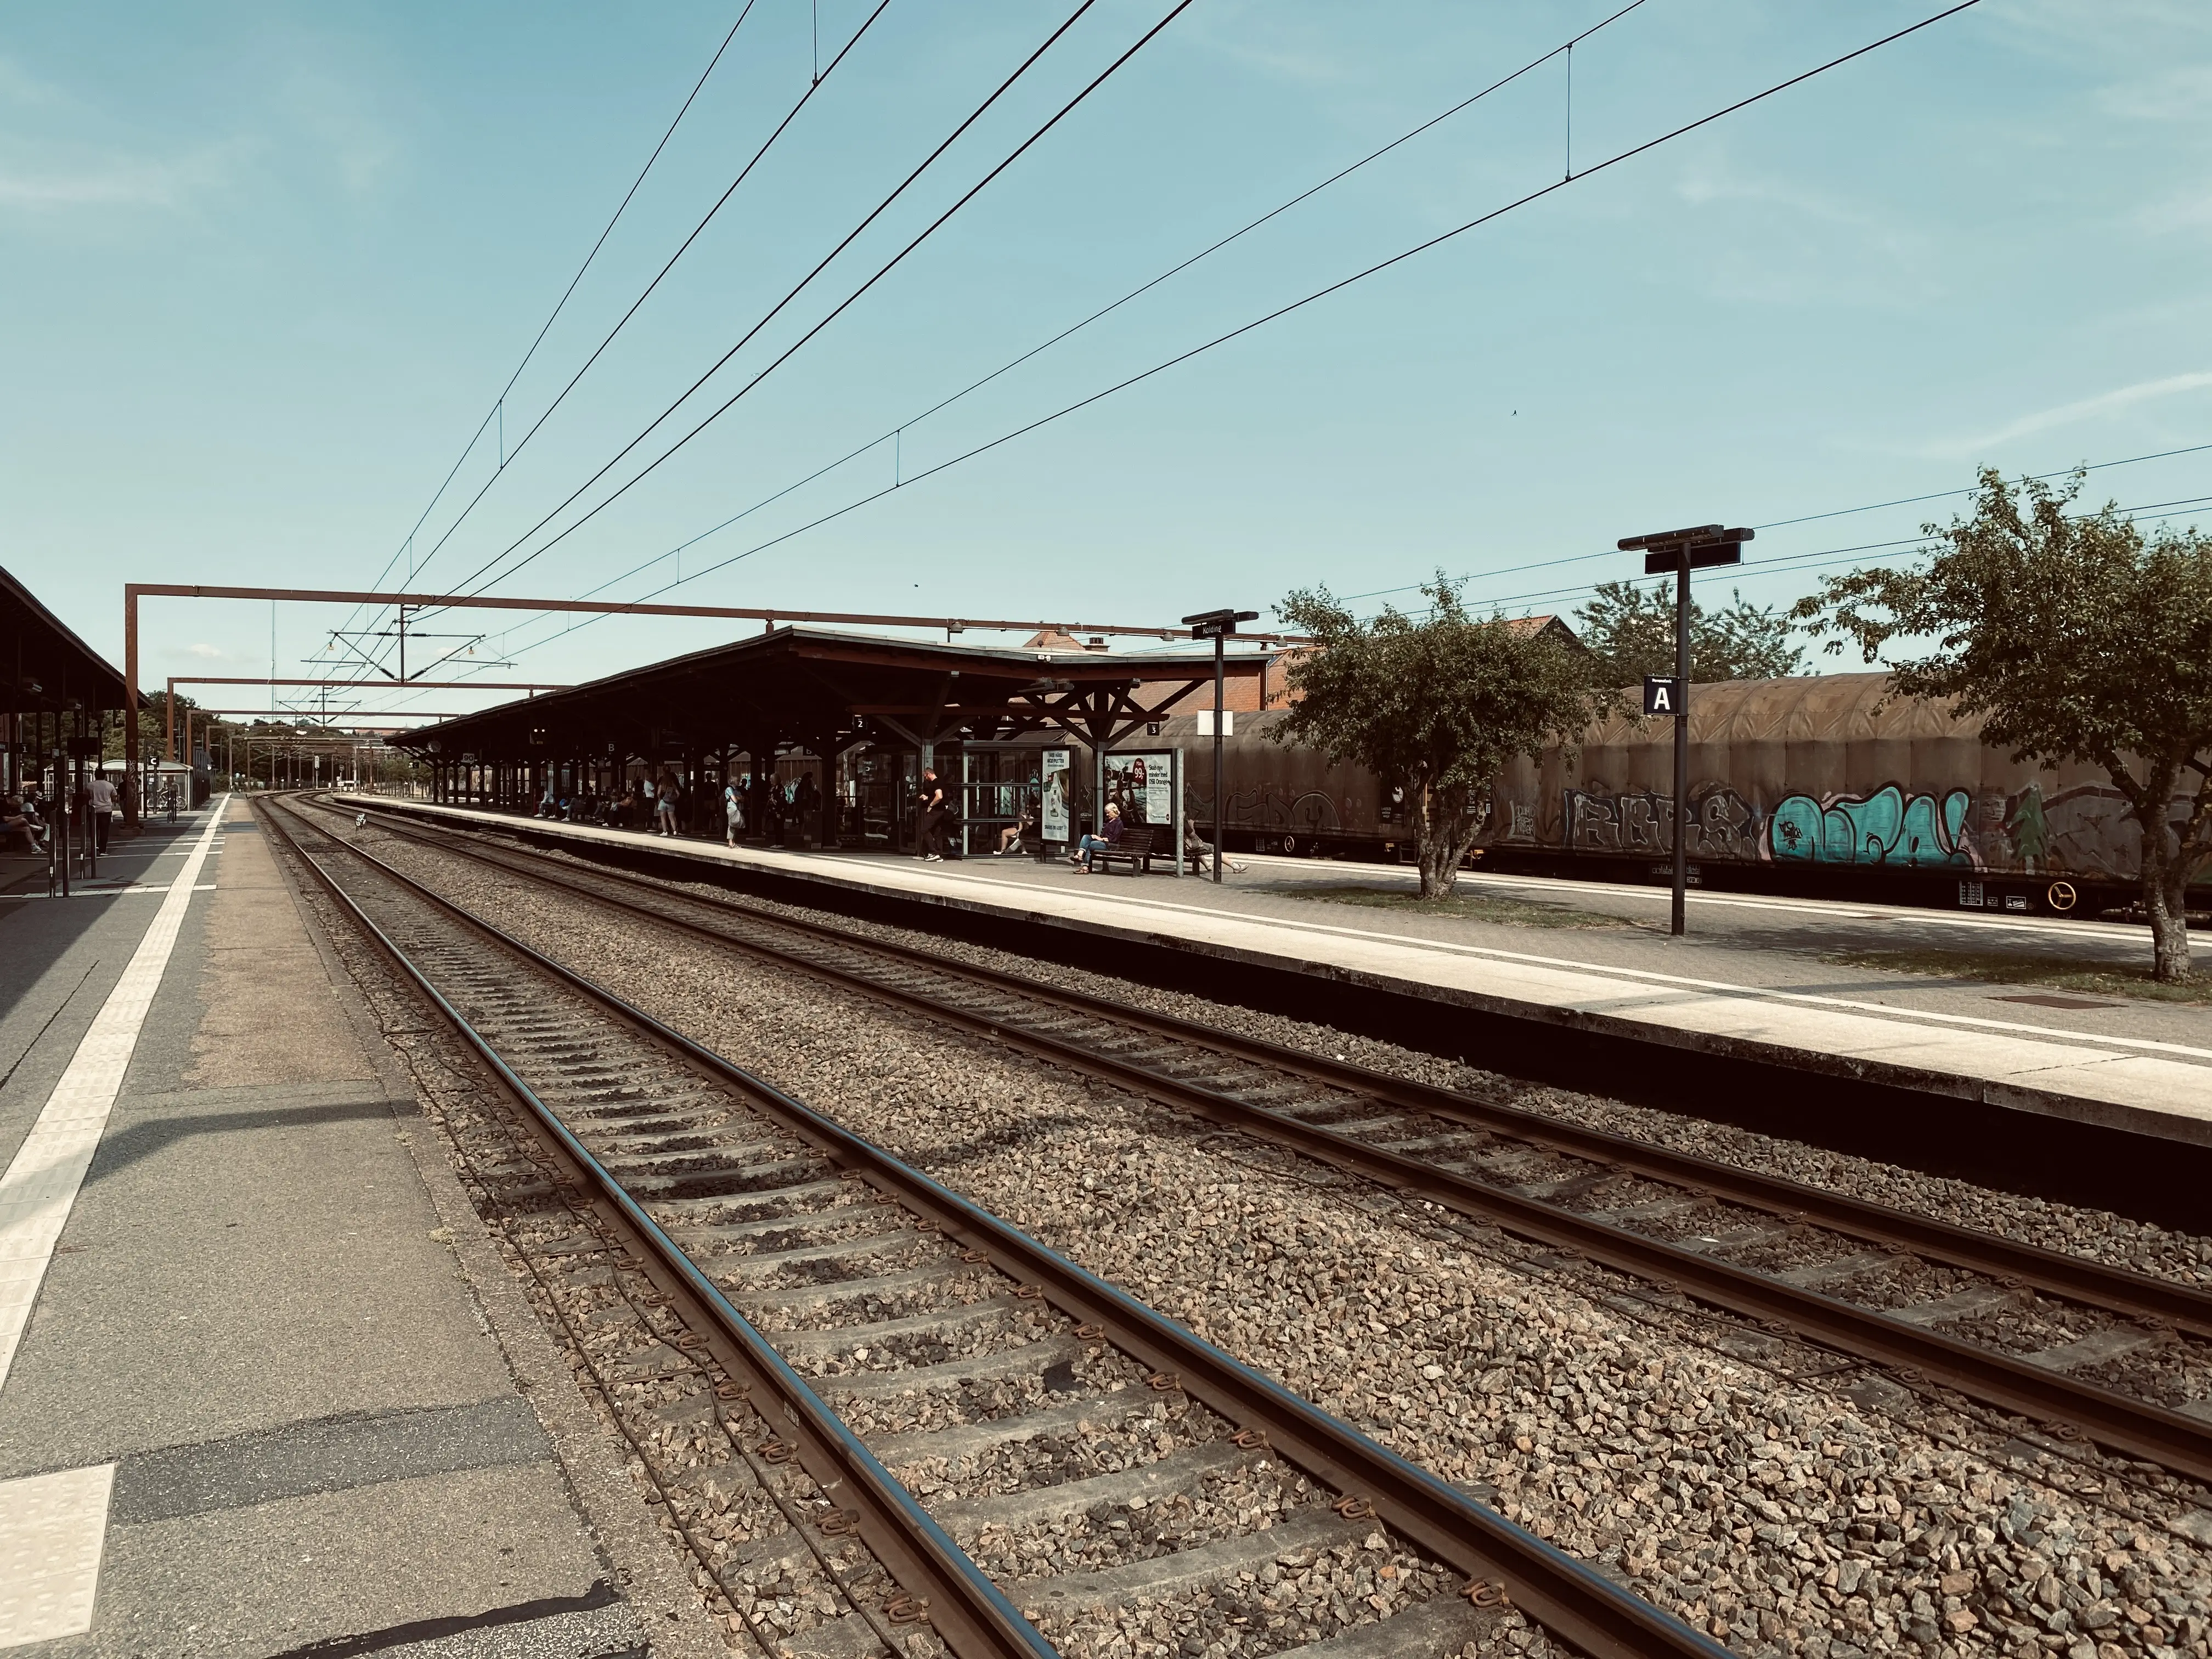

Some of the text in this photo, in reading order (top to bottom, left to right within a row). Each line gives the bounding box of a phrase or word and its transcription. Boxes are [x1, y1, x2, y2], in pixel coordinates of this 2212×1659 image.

[1203, 625, 1222, 634] Kolding
[1654, 687, 1671, 710] A
[608, 743, 615, 752] B
